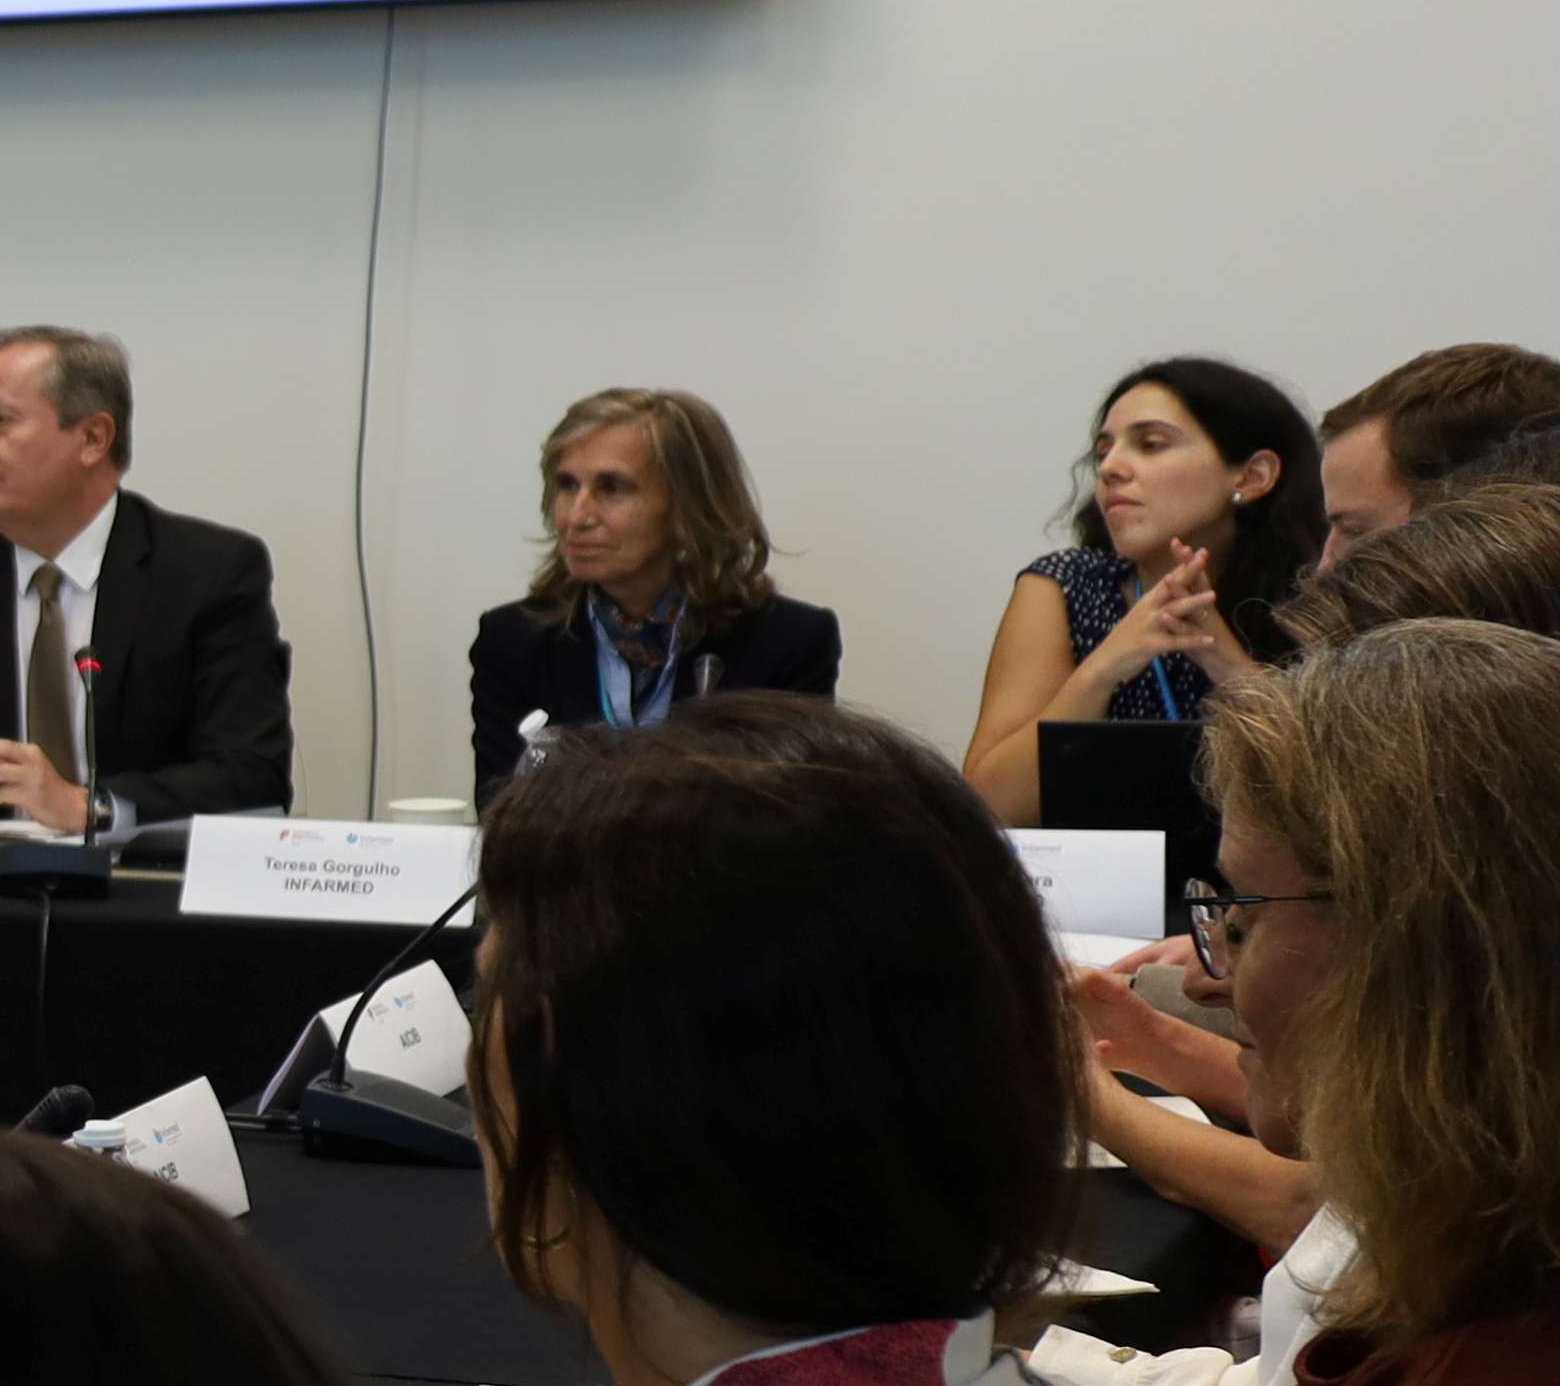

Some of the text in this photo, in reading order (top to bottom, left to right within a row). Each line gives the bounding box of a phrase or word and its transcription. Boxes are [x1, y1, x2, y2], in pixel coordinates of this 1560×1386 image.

[264, 856, 401, 877] Teresa Gorgulho
[285, 877, 375, 894] INFARMED
